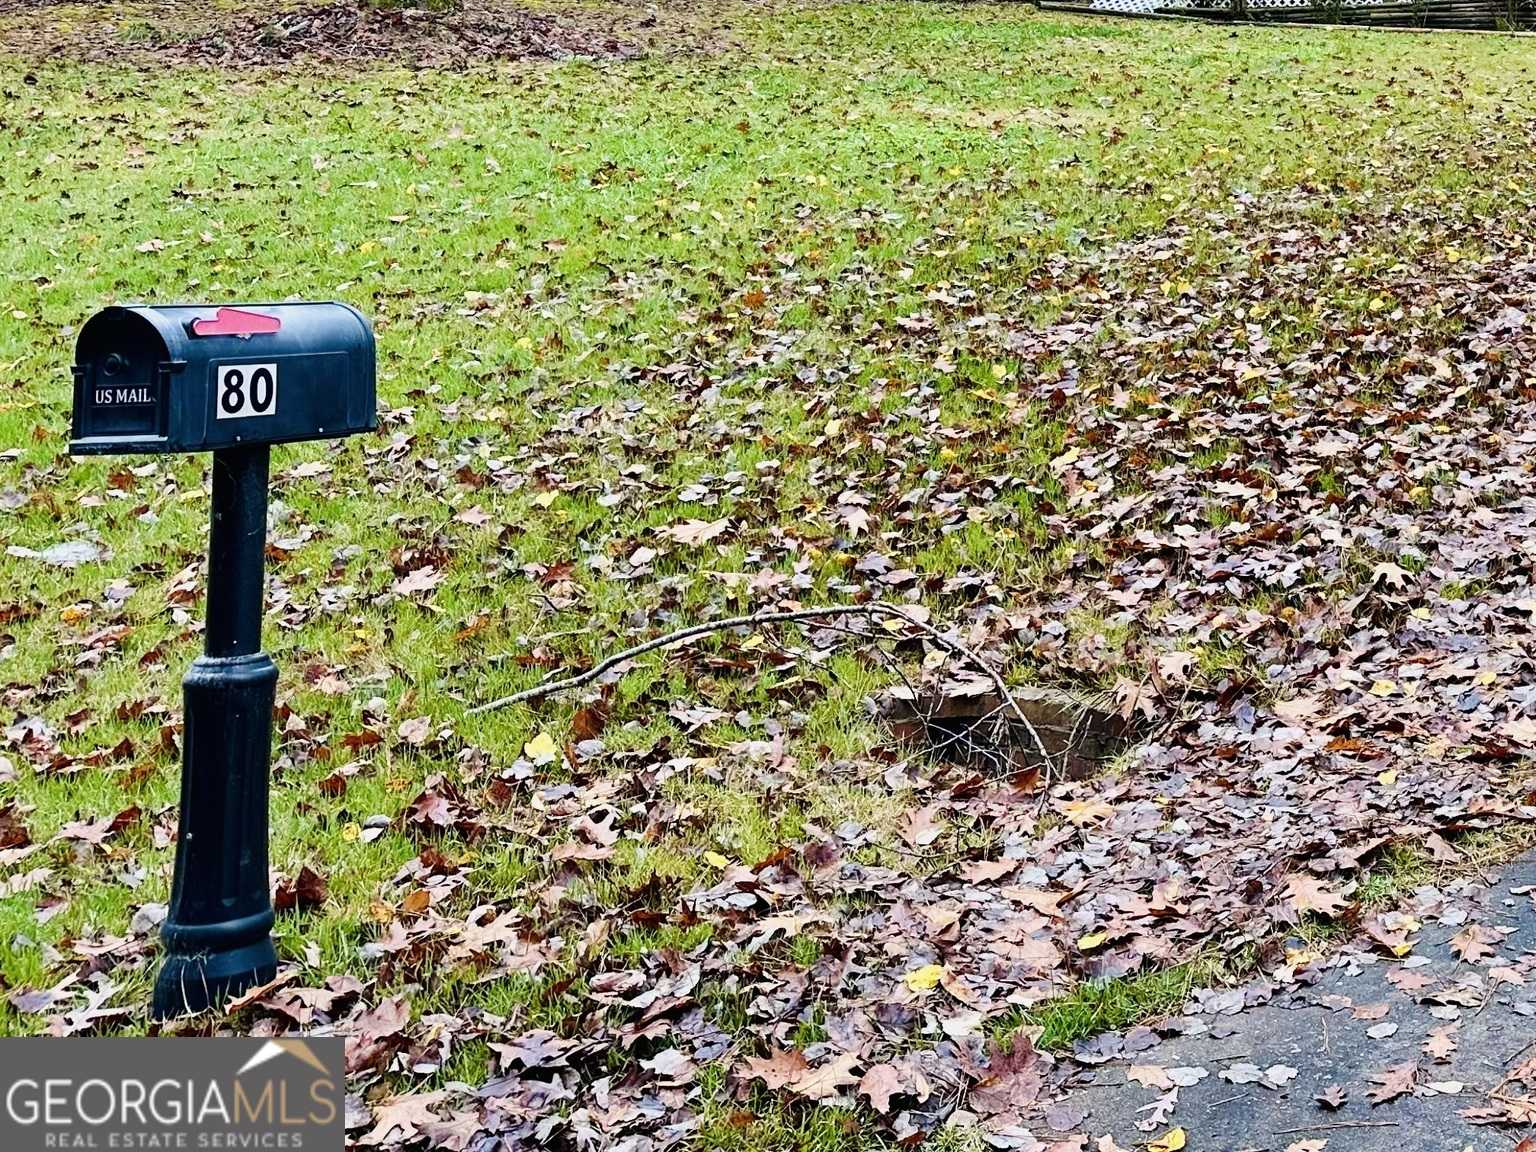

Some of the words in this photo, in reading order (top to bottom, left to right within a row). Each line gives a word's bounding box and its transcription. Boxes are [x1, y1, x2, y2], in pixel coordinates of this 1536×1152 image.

[95, 389, 113, 404] US
[116, 388, 152, 403] MAIL
[221, 367, 274, 415] 80
